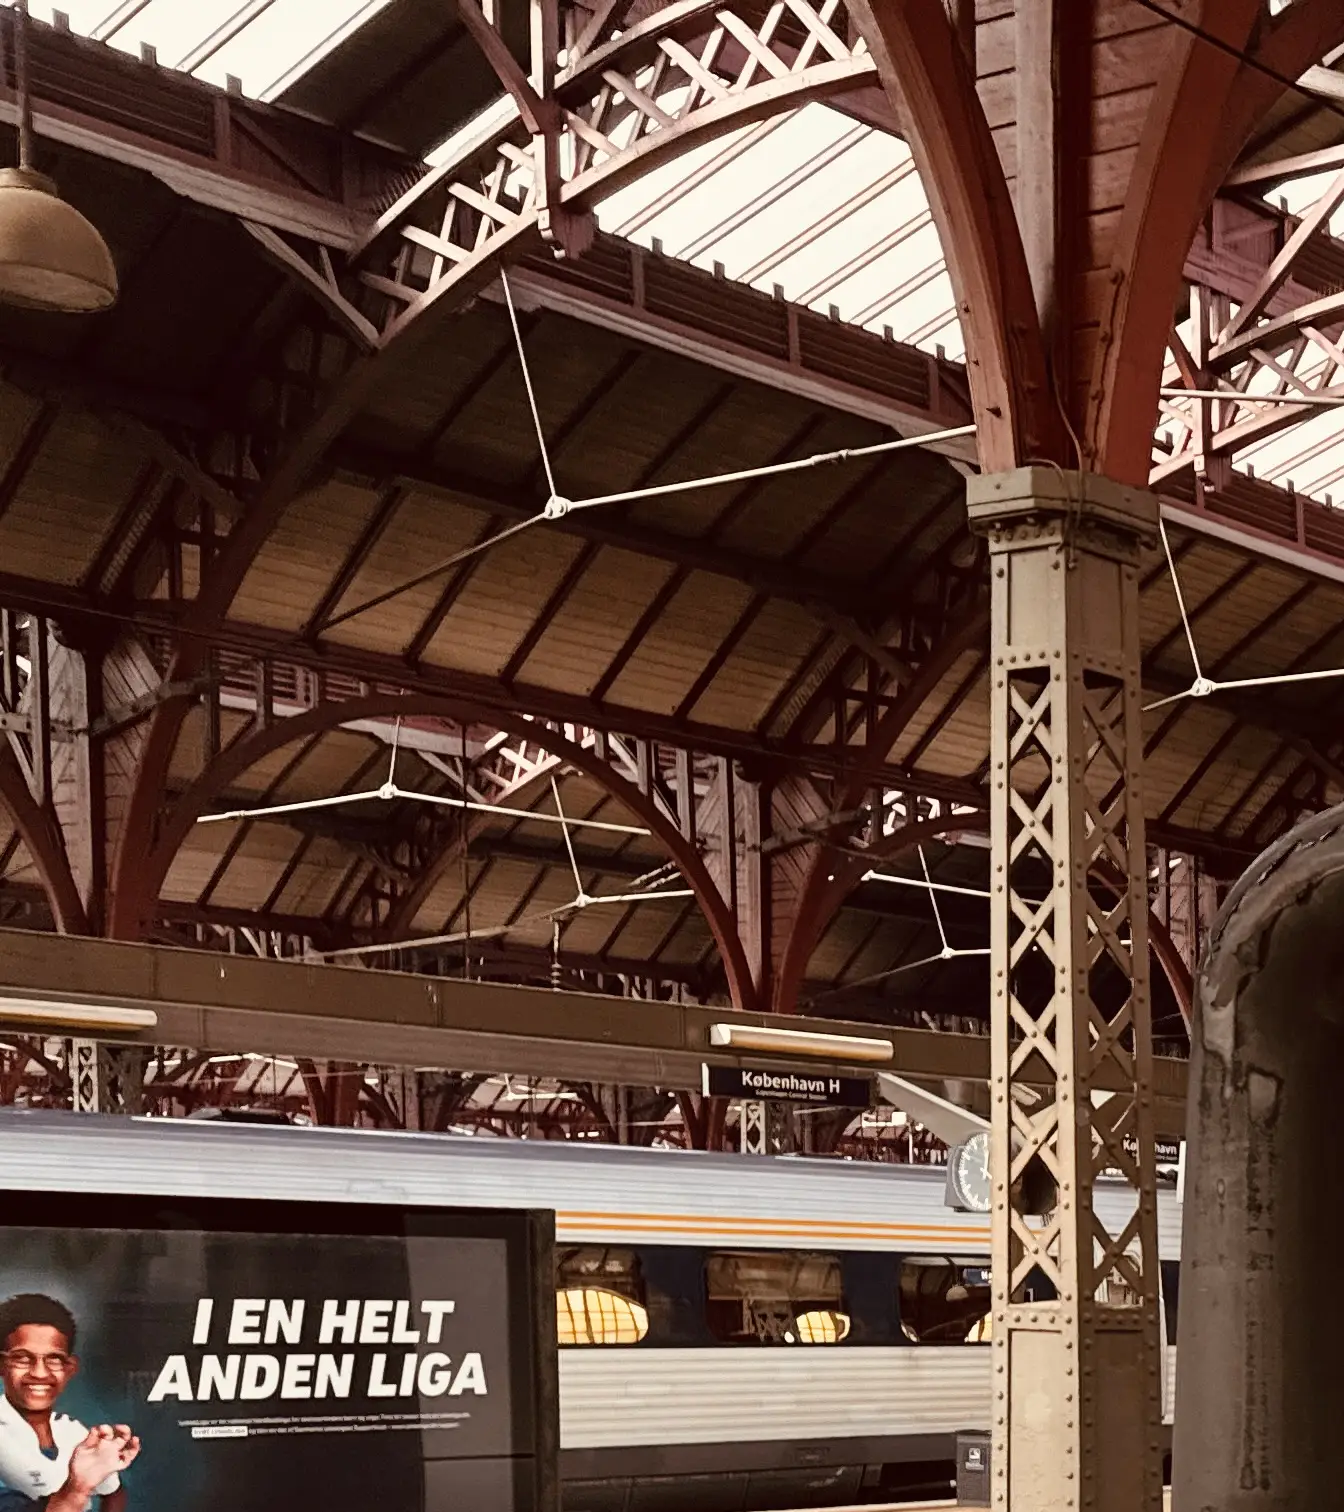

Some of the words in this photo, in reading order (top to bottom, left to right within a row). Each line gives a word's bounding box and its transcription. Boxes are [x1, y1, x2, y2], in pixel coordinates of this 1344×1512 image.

[741, 1070, 825, 1092] København
[829, 1079, 840, 1093] H
[193, 1298, 213, 1344] I
[228, 1299, 305, 1344] EN
[319, 1299, 455, 1344] HELT
[147, 1353, 354, 1402] ANDEN
[367, 1352, 488, 1398] LIGA
